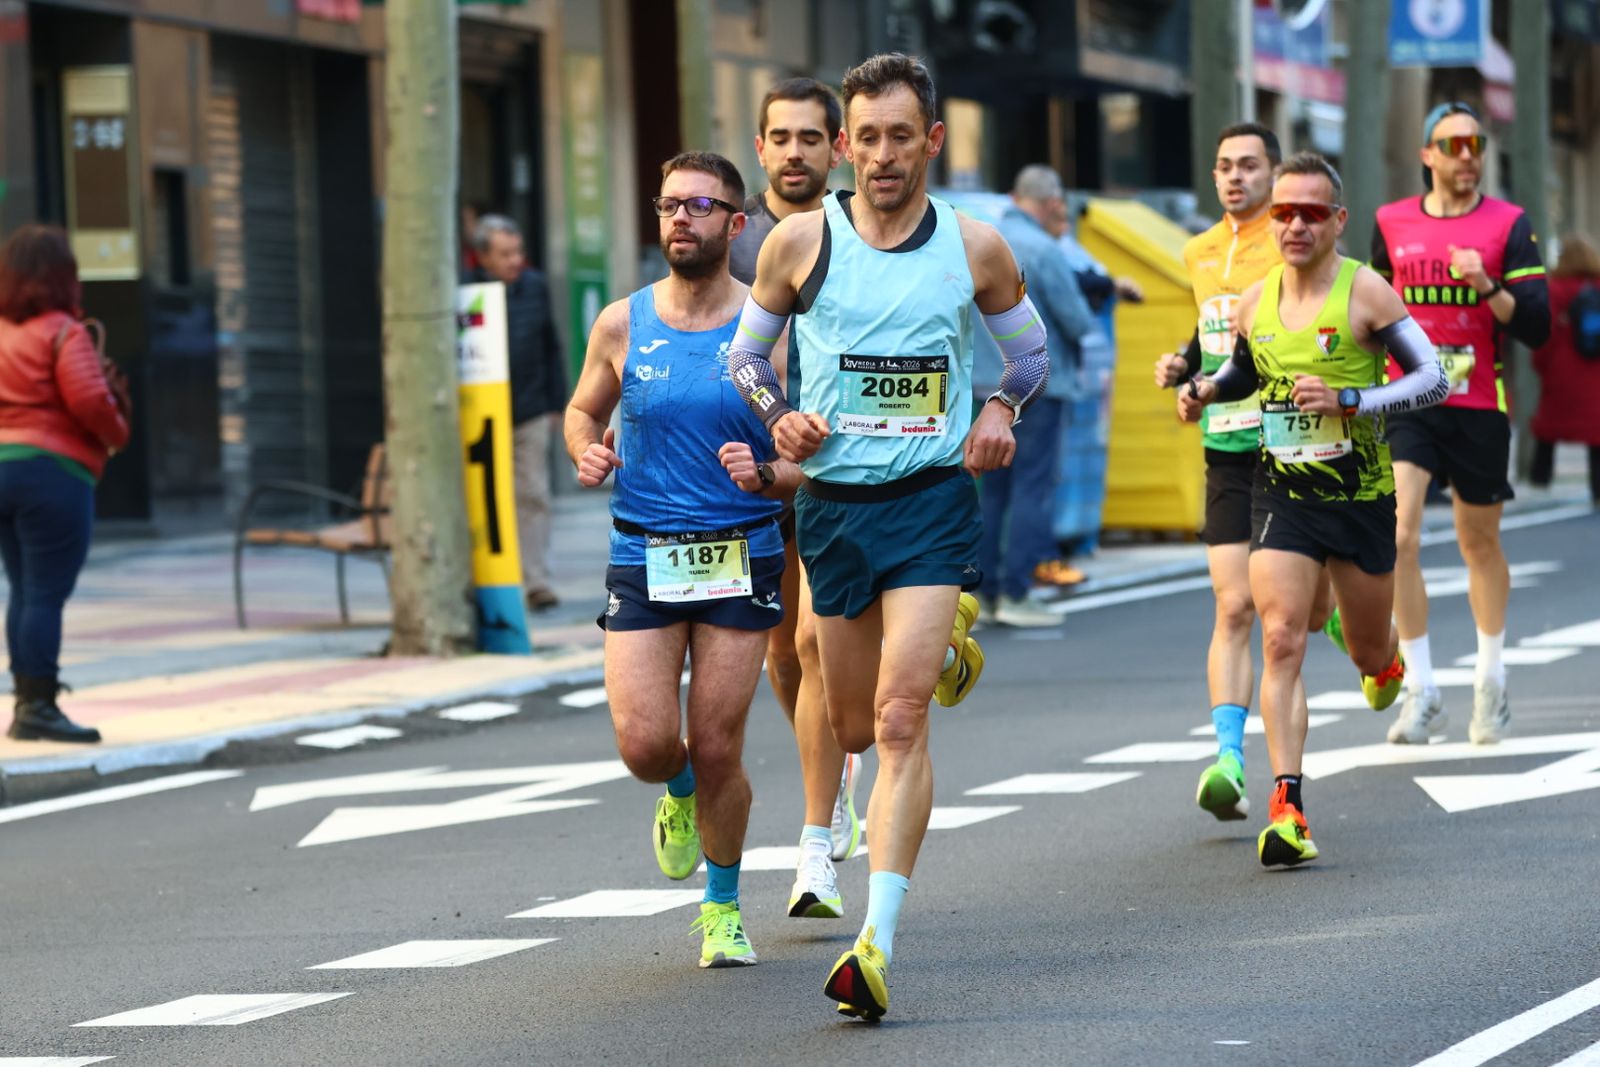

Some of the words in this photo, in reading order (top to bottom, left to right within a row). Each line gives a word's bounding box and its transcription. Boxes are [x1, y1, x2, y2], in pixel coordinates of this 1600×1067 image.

[902, 360, 921, 368] 2026
[861, 377, 929, 398] 2084
[902, 425, 936, 433] bedunia
[1284, 414, 1323, 431] 757
[467, 418, 503, 554] 1
[649, 537, 662, 545] XIV
[667, 545, 728, 567] 1187
